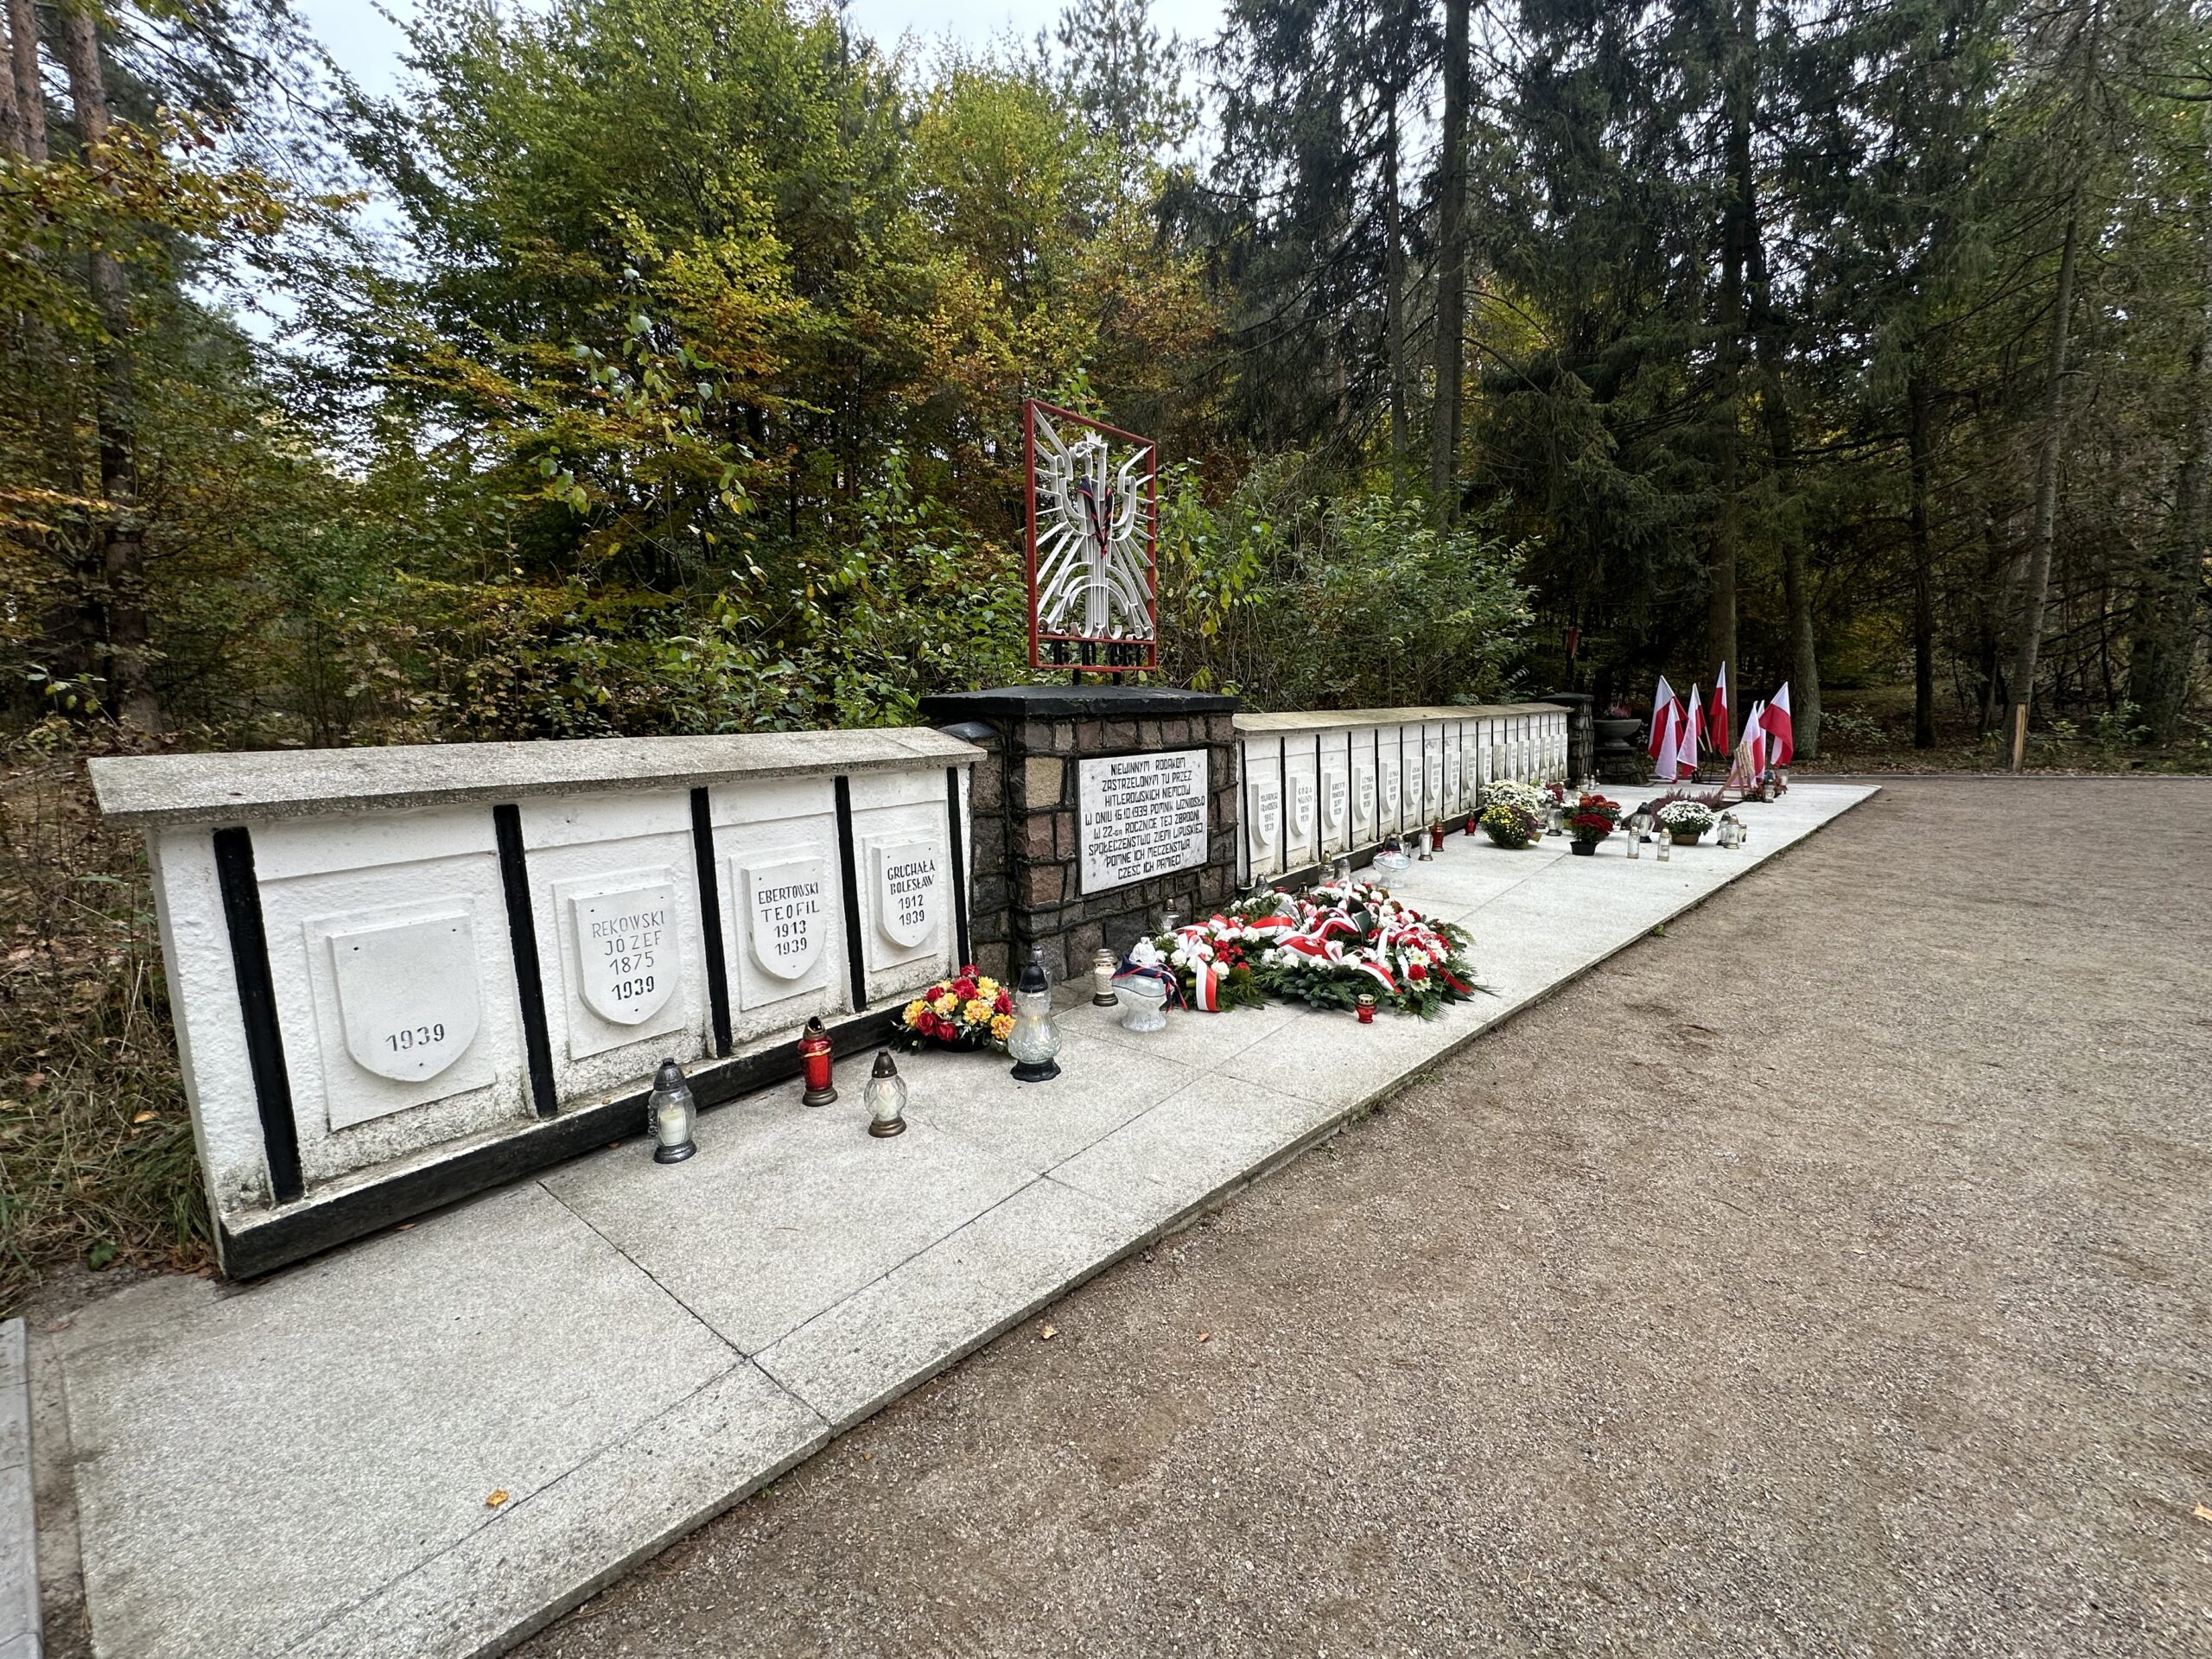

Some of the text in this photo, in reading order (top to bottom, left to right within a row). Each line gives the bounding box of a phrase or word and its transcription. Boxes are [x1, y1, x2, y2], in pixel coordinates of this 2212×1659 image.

[1111, 757, 1185, 776] NIEWINNYM RODAKOM
[1161, 773, 1170, 785] TU
[1173, 770, 1192, 783] PRZEZ
[1105, 788, 1160, 807] HITLEROWSKICH
[1085, 813, 1092, 826] W
[1096, 810, 1112, 824] DNIU
[1150, 800, 1174, 816] POMNIK
[1094, 828, 1101, 840] W
[1160, 815, 1173, 828] TEJ
[1089, 833, 1151, 856] SPOŁECZEŃSTWO
[1154, 829, 1172, 843] ZIEMI
[1106, 851, 1132, 868] POMNE
[1134, 849, 1145, 861] ICH
[1143, 861, 1154, 874] ICH
[887, 859, 936, 880] GRUCHAŁA
[758, 881, 819, 905] EBERTOWSKI
[890, 874, 935, 895] BOLESŁAW
[760, 899, 820, 923] TEOFIL
[899, 894, 924, 910] 1912
[592, 910, 665, 938] REKOWSKI
[899, 909, 925, 926] 1939
[773, 919, 806, 938] 1913
[604, 930, 662, 956] JÓZEF
[774, 937, 808, 956] 1939
[609, 950, 654, 976] 1875
[612, 976, 655, 1001] 1939
[385, 1023, 445, 1052] 1939
